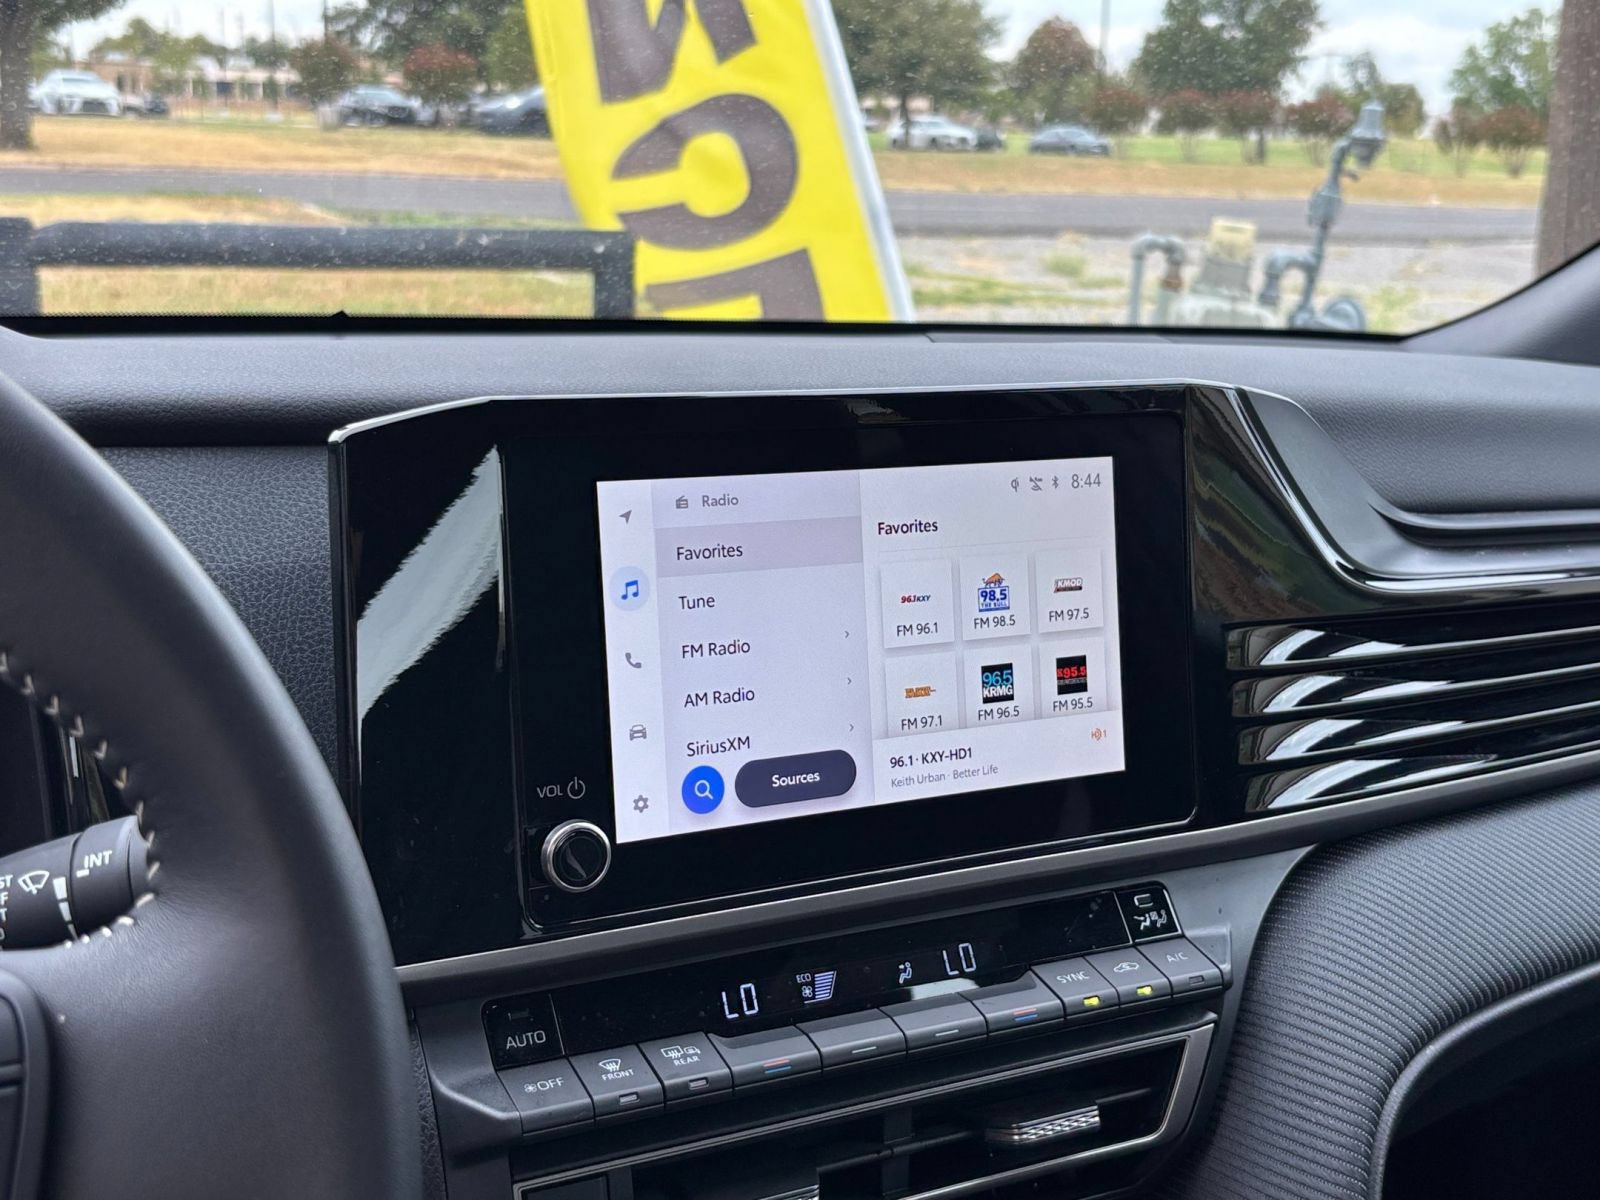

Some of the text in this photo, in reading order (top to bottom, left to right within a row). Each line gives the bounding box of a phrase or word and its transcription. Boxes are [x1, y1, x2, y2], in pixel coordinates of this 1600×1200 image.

[1071, 473, 1102, 489] 8:44
[702, 494, 739, 507] Radio
[877, 519, 939, 535] Favorites
[676, 543, 743, 561] Favorites
[678, 594, 716, 610] Tune
[980, 588, 1007, 602] 98.5
[974, 615, 1016, 630] FM 98.5
[1049, 608, 1089, 622] FM 97.5
[896, 622, 939, 637] FM 96.1
[682, 639, 751, 659] FM Radio
[982, 670, 1012, 687] 96.5
[683, 687, 755, 708] AM Radio
[982, 684, 1013, 698] KRMG
[1053, 697, 1093, 713] FM 95.5
[978, 706, 1020, 721] FM 96.5
[901, 715, 943, 731] FM 97.1
[686, 735, 751, 757] SiriusXM
[889, 747, 973, 769] 96.1 KXY-HD1
[771, 771, 821, 788] Sources
[891, 764, 999, 788] Keith Urban Better Life
[536, 784, 563, 799] VOL
[84, 850, 113, 869] INT
[942, 942, 977, 976] LO
[1166, 951, 1189, 964] A/C
[796, 973, 812, 984] ECO
[1056, 970, 1090, 985] SYNC
[721, 982, 759, 1019] LO
[506, 1029, 546, 1050] AUTO
[673, 1054, 700, 1067] REAR
[601, 1068, 634, 1082] FRONT
[536, 1077, 565, 1093] OFF
